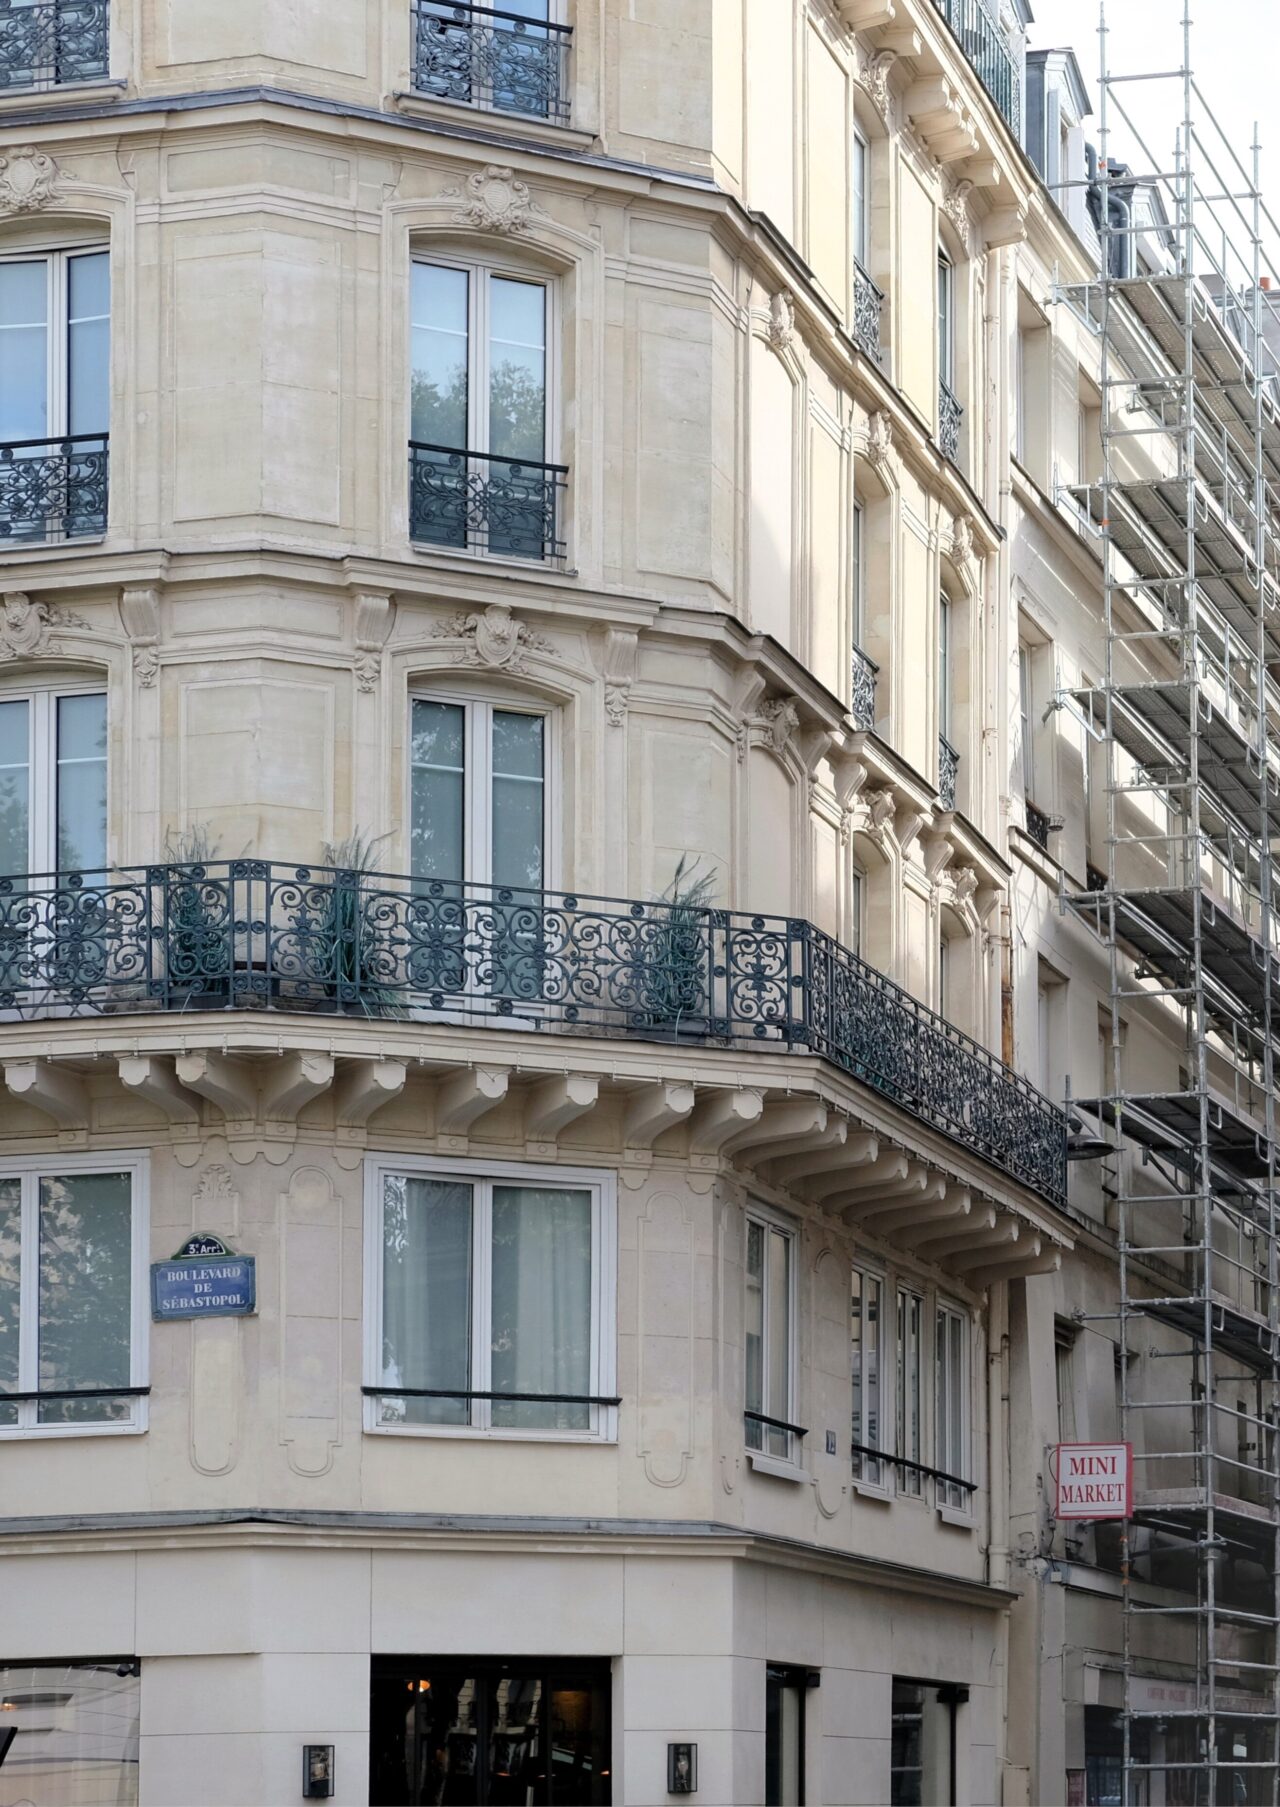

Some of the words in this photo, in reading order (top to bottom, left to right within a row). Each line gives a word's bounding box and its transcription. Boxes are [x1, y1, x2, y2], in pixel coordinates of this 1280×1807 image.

[167, 1266, 241, 1282] BOULEVARD
[194, 1282, 213, 1294] DE
[162, 1294, 245, 1310] SÉBASTOPOL
[1069, 1456, 1117, 1476] MINI
[1061, 1483, 1124, 1504] MARKET
